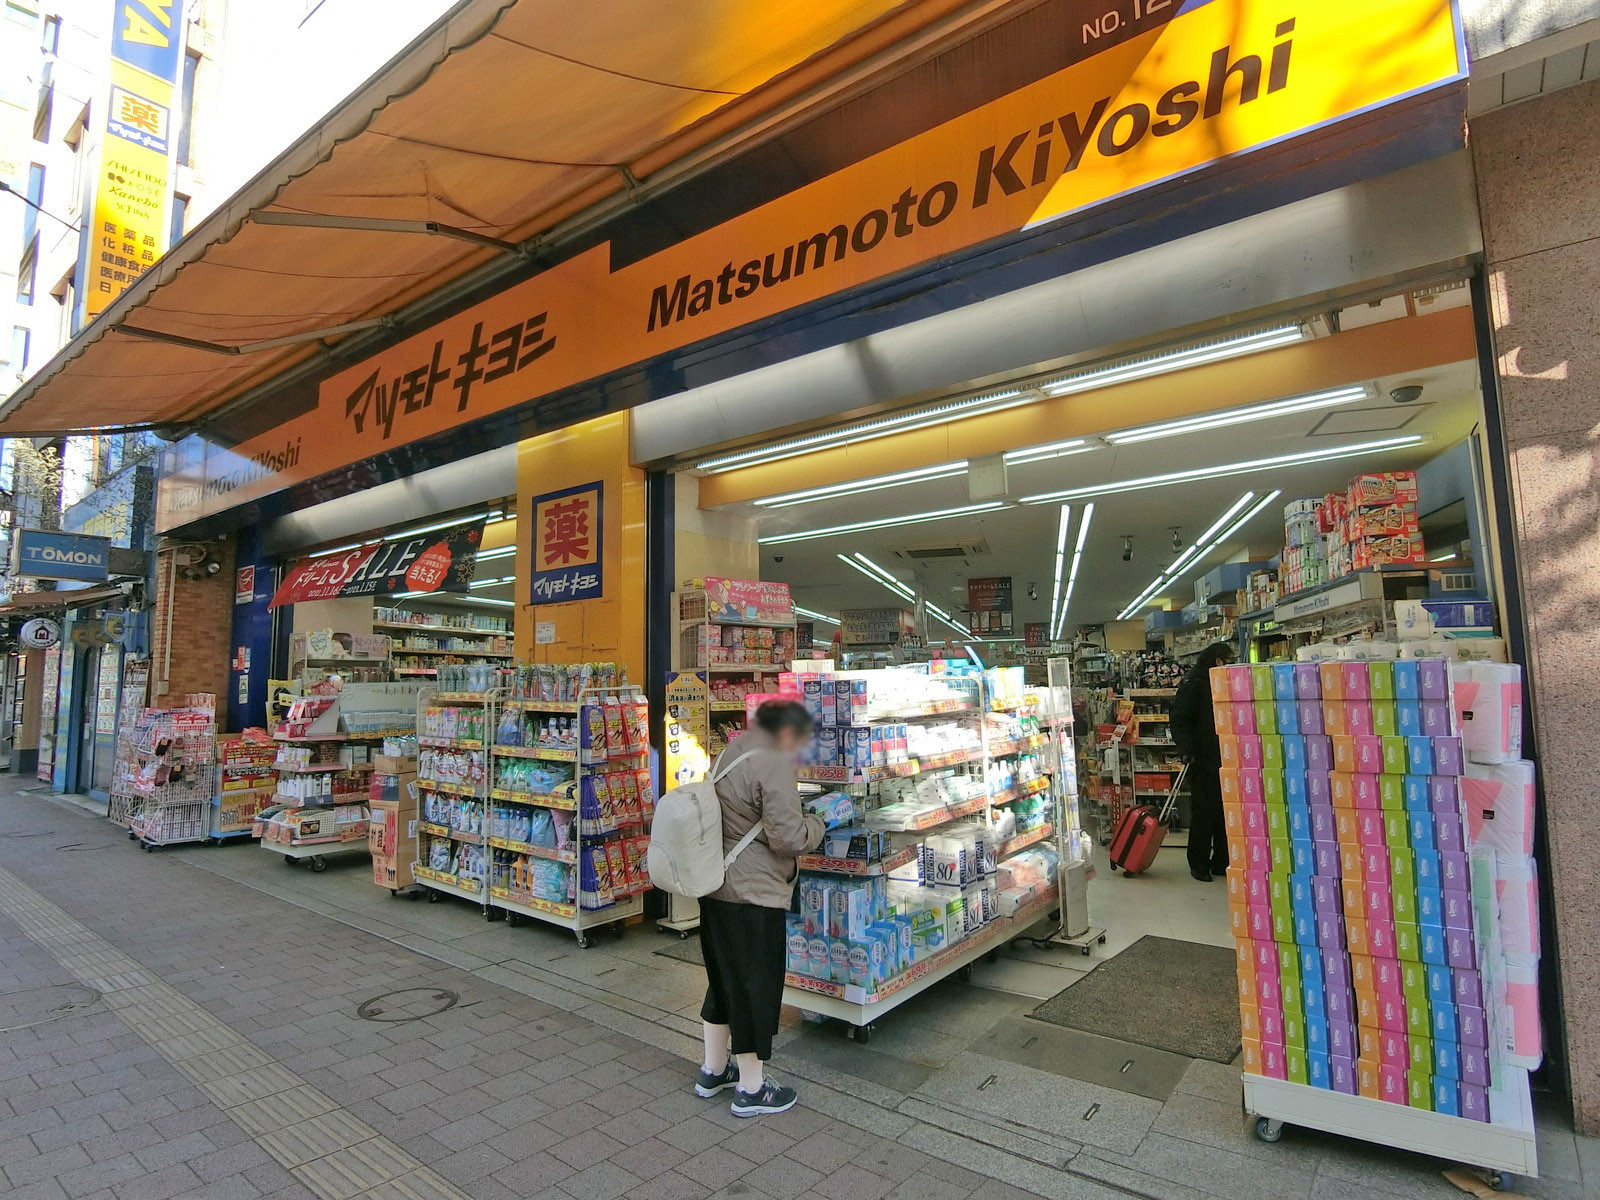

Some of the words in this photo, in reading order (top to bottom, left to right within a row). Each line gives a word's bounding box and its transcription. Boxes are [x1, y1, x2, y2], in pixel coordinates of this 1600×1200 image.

[120, 96, 160, 135] 薬
[107, 160, 167, 187] SHISEIDO
[108, 186, 159, 209] Kanebo
[646, 180, 959, 334] Matsumoto
[345, 310, 558, 441] マツモトキヨシ
[543, 498, 590, 566] 薬
[328, 538, 427, 585] SALE
[533, 572, 599, 598] マツモトキヨシ
[936, 862, 953, 881] 80
[762, 1091, 773, 1103] N
